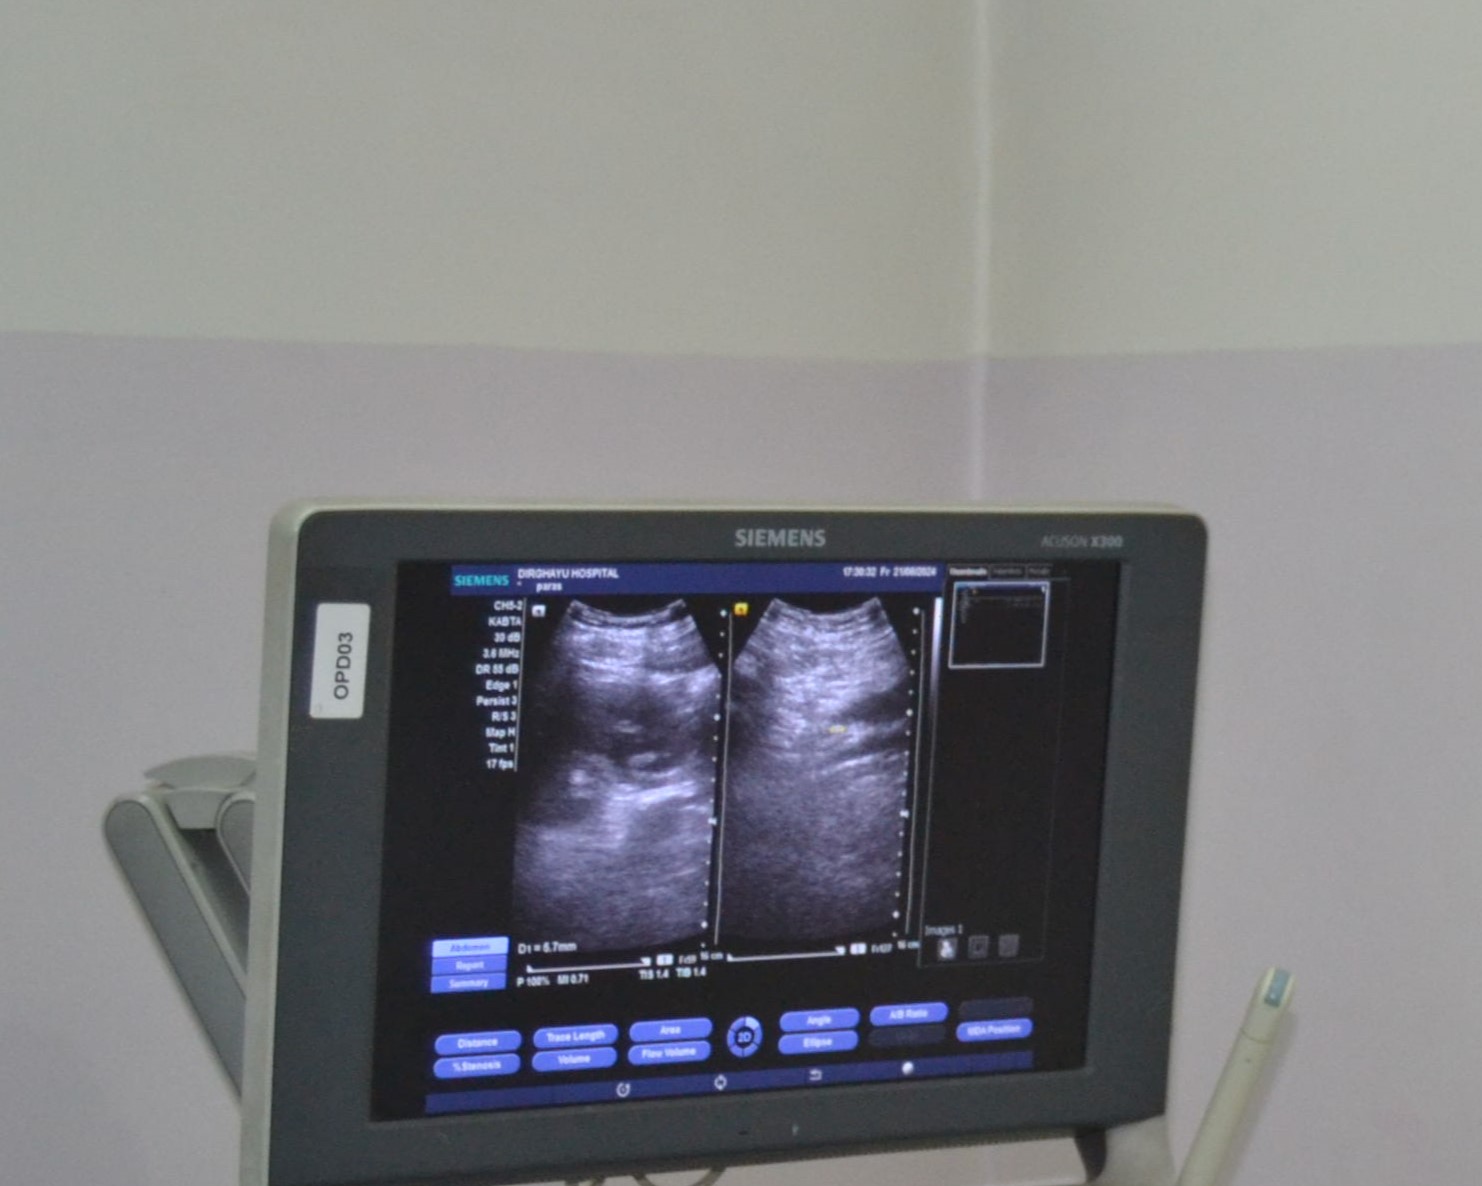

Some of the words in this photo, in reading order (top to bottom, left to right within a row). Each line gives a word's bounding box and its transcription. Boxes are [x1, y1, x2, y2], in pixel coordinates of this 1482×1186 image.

[735, 529, 827, 548] SIEMENS
[517, 568, 570, 580] DIRGHAYU
[570, 567, 620, 579] HOSPITAL
[454, 574, 509, 587] SIEMENS
[333, 631, 353, 700] OPD03
[449, 979, 489, 989] Summary
[806, 1015, 832, 1027] Angle
[547, 1033, 571, 1043] Trace
[573, 1030, 606, 1043] Length
[659, 1025, 681, 1036] Area
[457, 1037, 499, 1049] Distance
[803, 1037, 833, 1049] Ellipse
[642, 1048, 663, 1059] Flow
[664, 1047, 696, 1058] Volume
[557, 1054, 591, 1065] Volume
